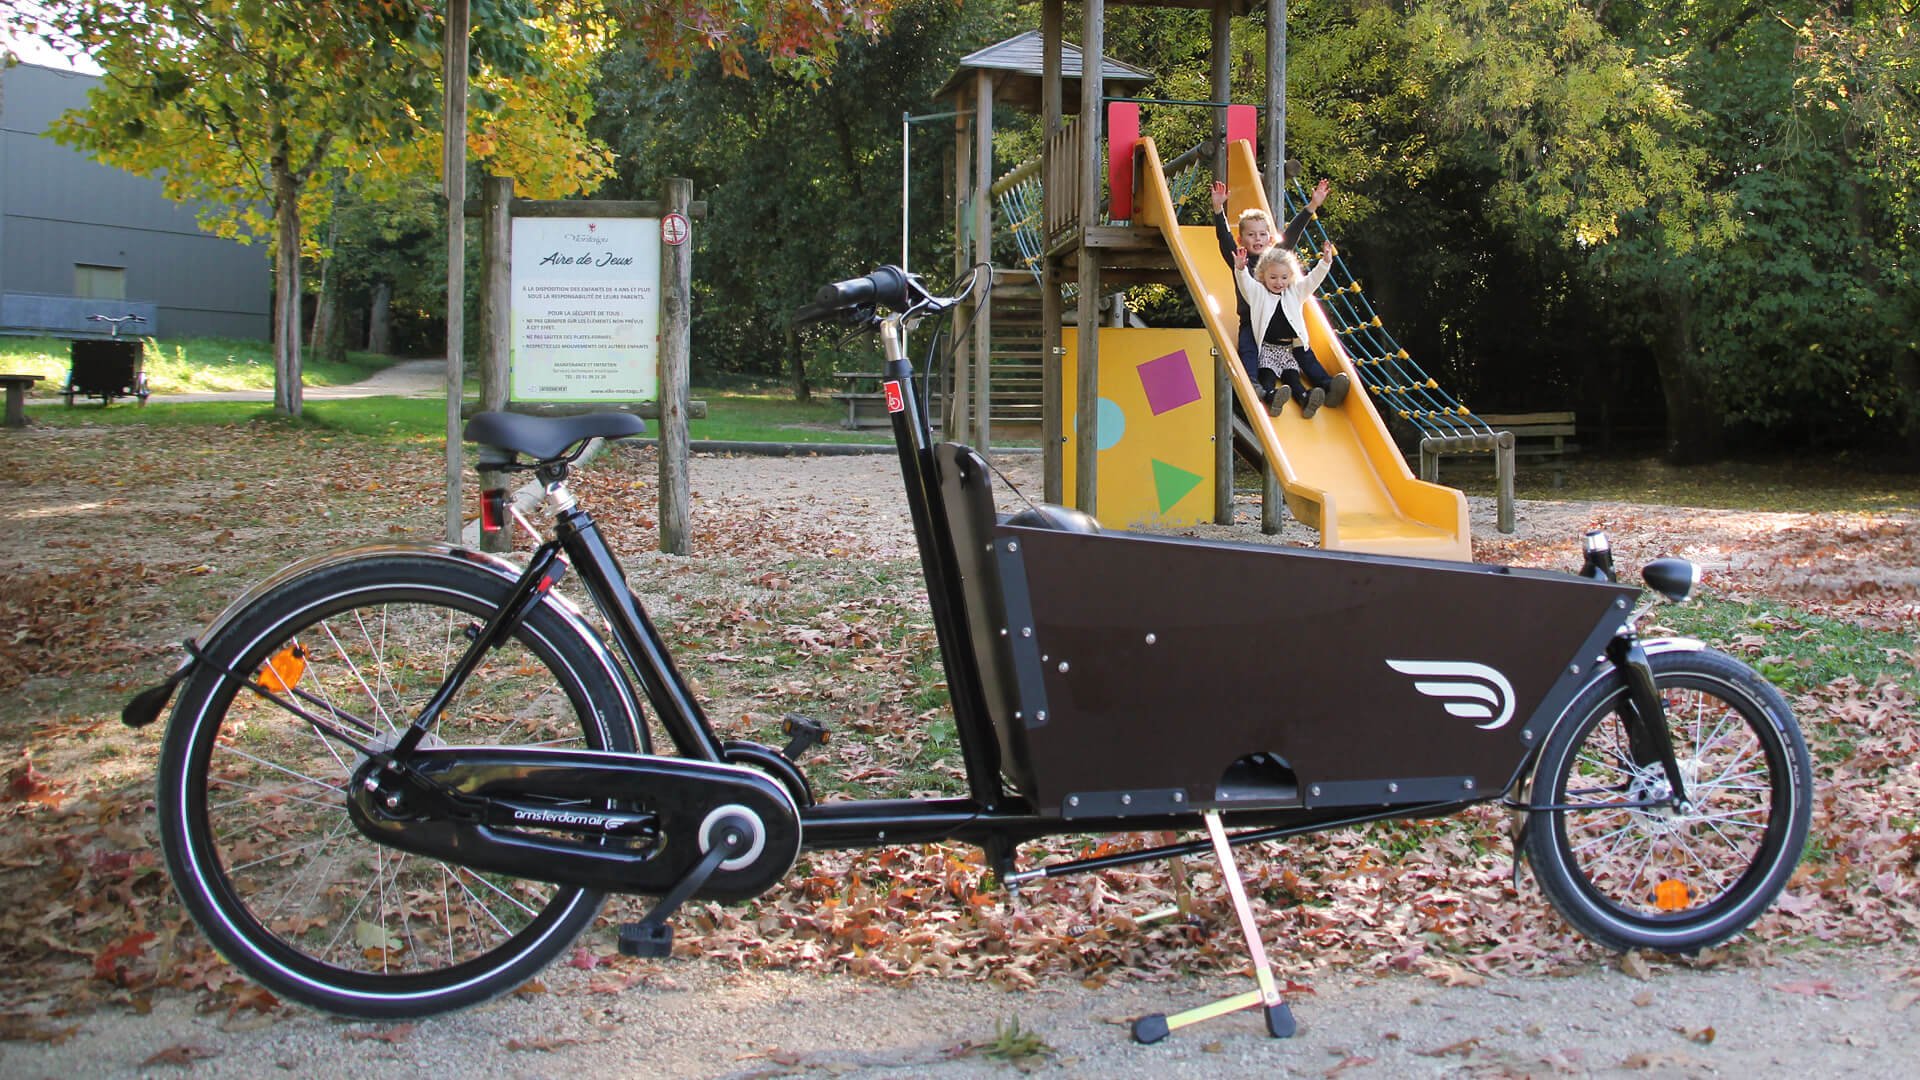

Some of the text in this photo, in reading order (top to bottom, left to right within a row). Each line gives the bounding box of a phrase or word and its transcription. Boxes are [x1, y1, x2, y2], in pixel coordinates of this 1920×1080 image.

[539, 252, 632, 268] Aire de Jeux
